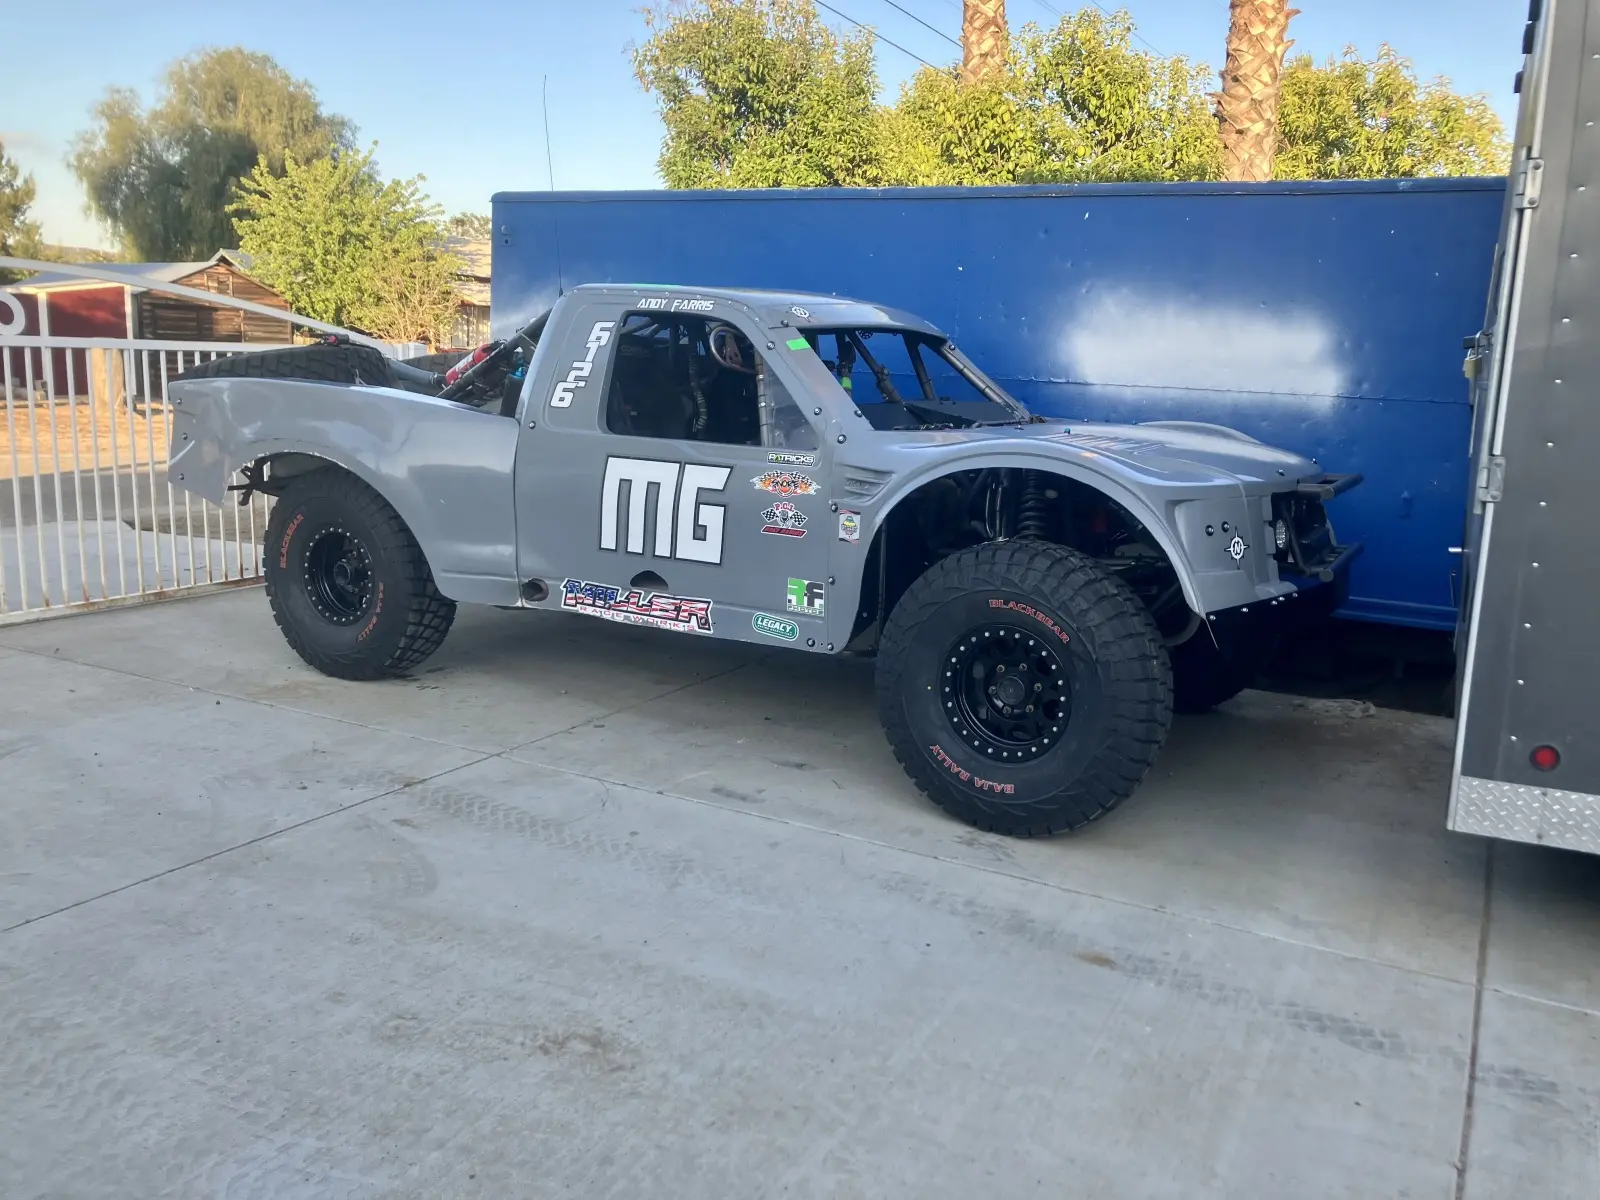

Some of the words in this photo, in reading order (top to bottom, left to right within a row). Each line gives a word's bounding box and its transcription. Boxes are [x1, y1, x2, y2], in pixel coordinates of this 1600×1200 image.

[637, 298, 668, 309] ANDY
[671, 299, 715, 312] FARRIS
[550, 321, 616, 408] 6126
[600, 455, 733, 566] MG
[280, 513, 304, 569] BLACKBEAR
[562, 579, 712, 631] MILLER
[578, 605, 625, 619] RACE
[631, 615, 697, 631] WORKS
[757, 616, 793, 633] LEGACY
[988, 599, 1070, 644] BLACKBEAR
[930, 744, 970, 781] RALLY
[974, 776, 1015, 794] BAJA
